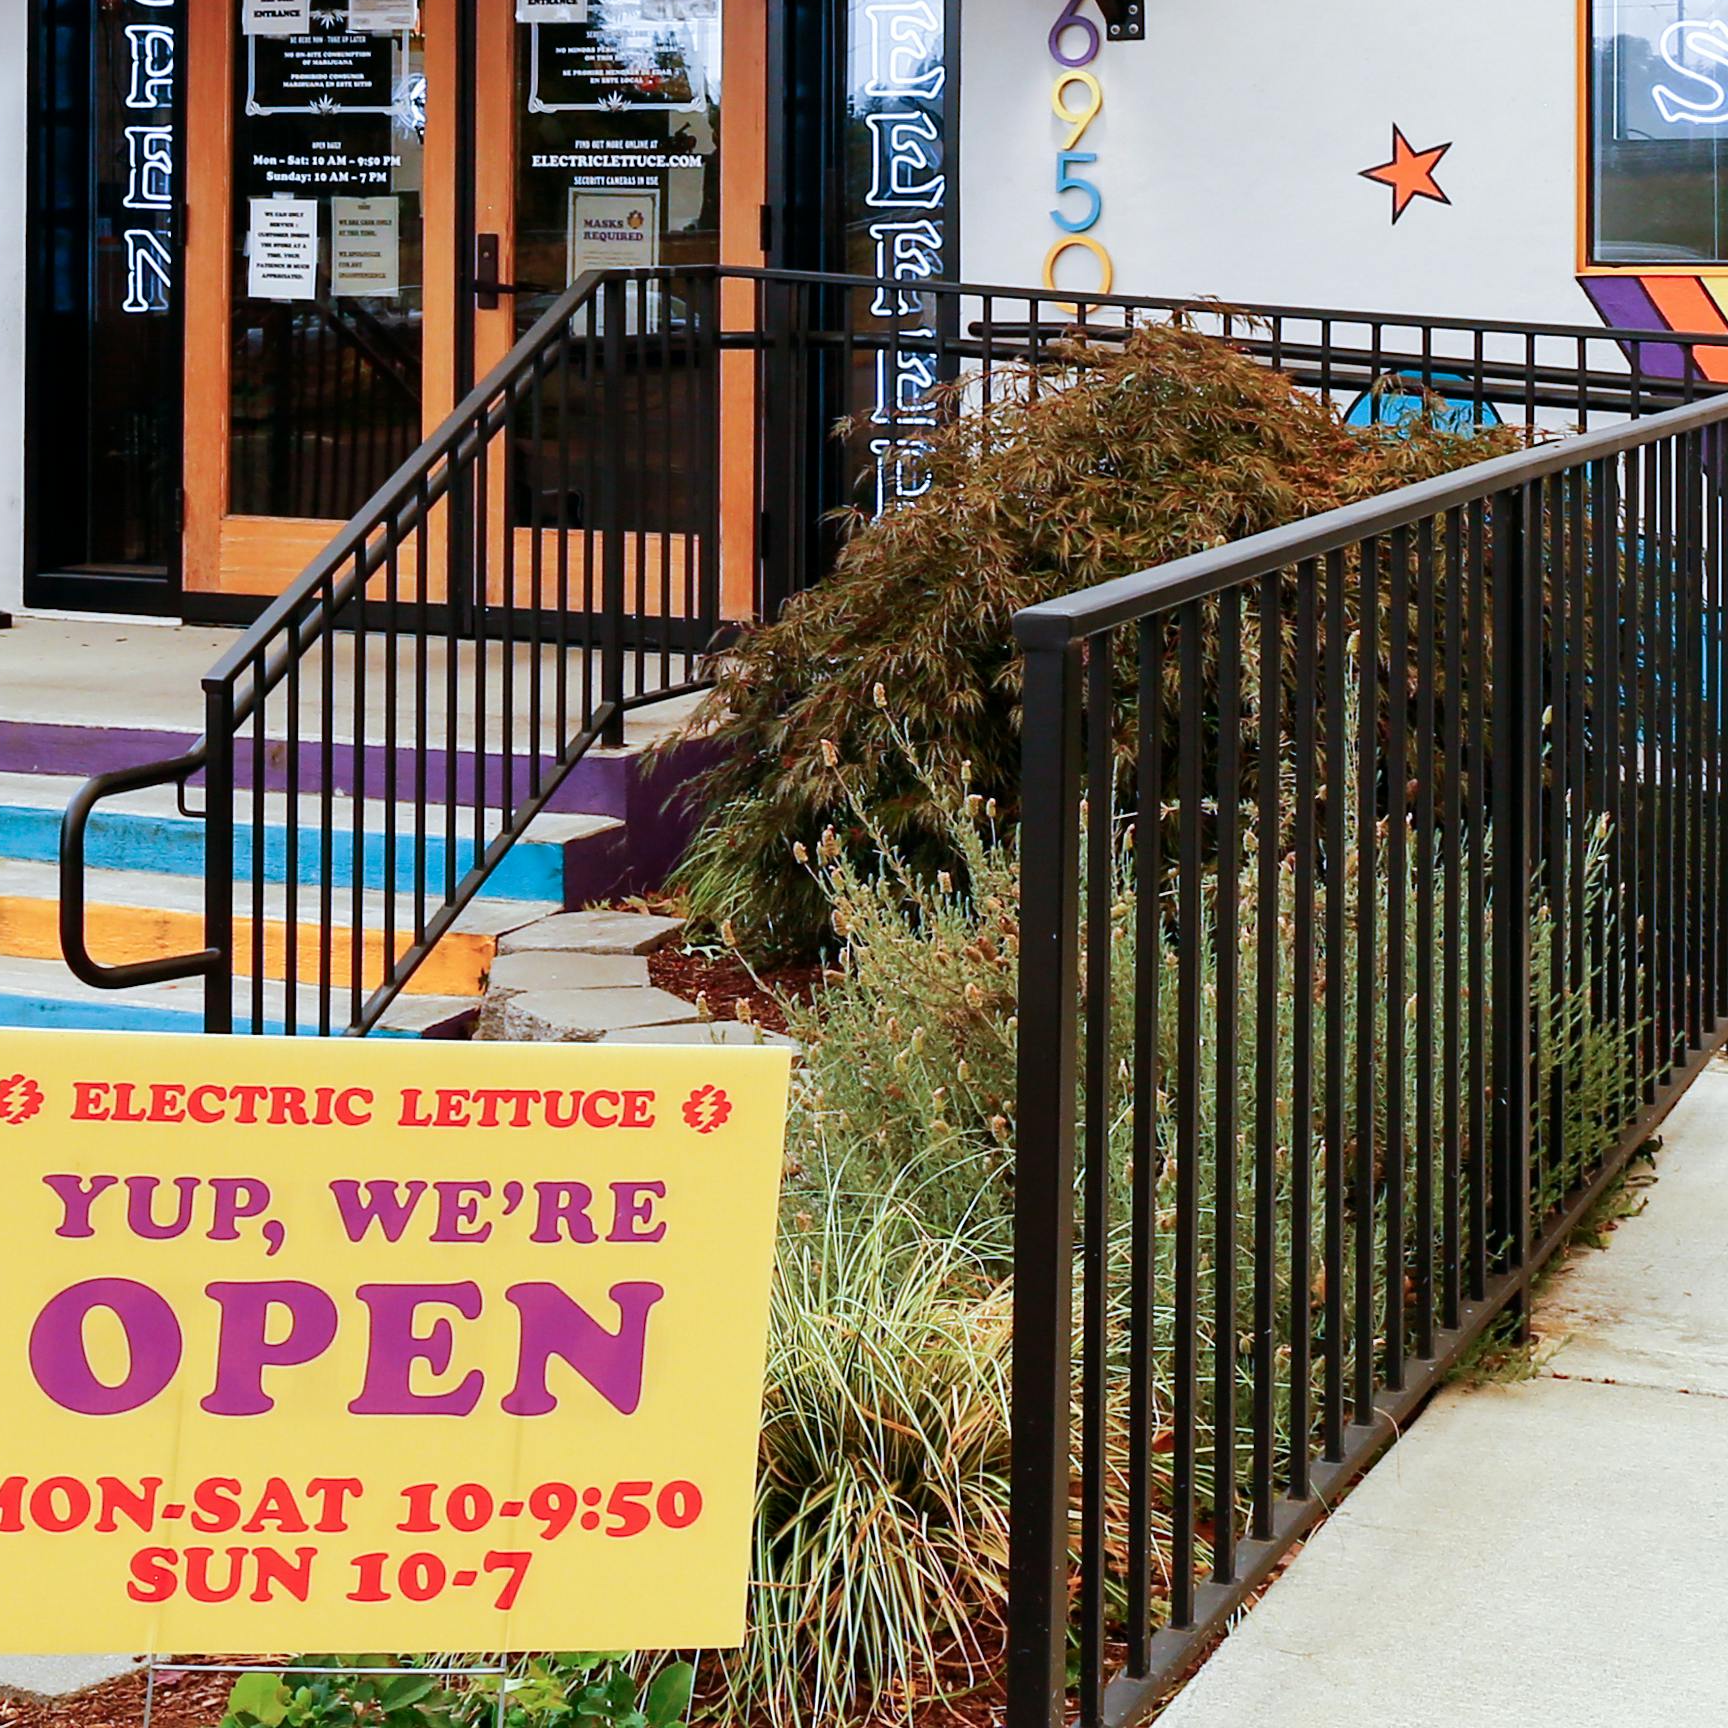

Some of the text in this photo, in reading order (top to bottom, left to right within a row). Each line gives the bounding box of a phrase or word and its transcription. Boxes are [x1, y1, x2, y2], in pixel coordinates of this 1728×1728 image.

[254, 9, 301, 18] ENTRANCE
[253, 156, 277, 166] Mon
[287, 155, 310, 166] Sat:
[312, 156, 325, 166] 10
[327, 155, 347, 166] AM
[357, 156, 381, 167] 9:50
[382, 155, 401, 167] PM
[532, 155, 702, 167] ELECTRICLETTUCE.COM
[266, 171, 312, 184] Sunday:
[314, 172, 327, 182] 10
[329, 171, 349, 182] AM
[359, 173, 367, 184] 7
[369, 172, 387, 183] PM
[573, 176, 605, 185] SECURITY
[583, 219, 624, 228] MASKS
[583, 232, 644, 242] REQUIRED
[71, 1081, 656, 1129] ELECTRIC LETTUCE
[43, 1174, 668, 1256] YUP, WE'RE
[28, 1277, 665, 1416] OPEN
[397, 1480, 703, 1541] 10-9:50
[126, 1547, 533, 1611] SUN 10-7
